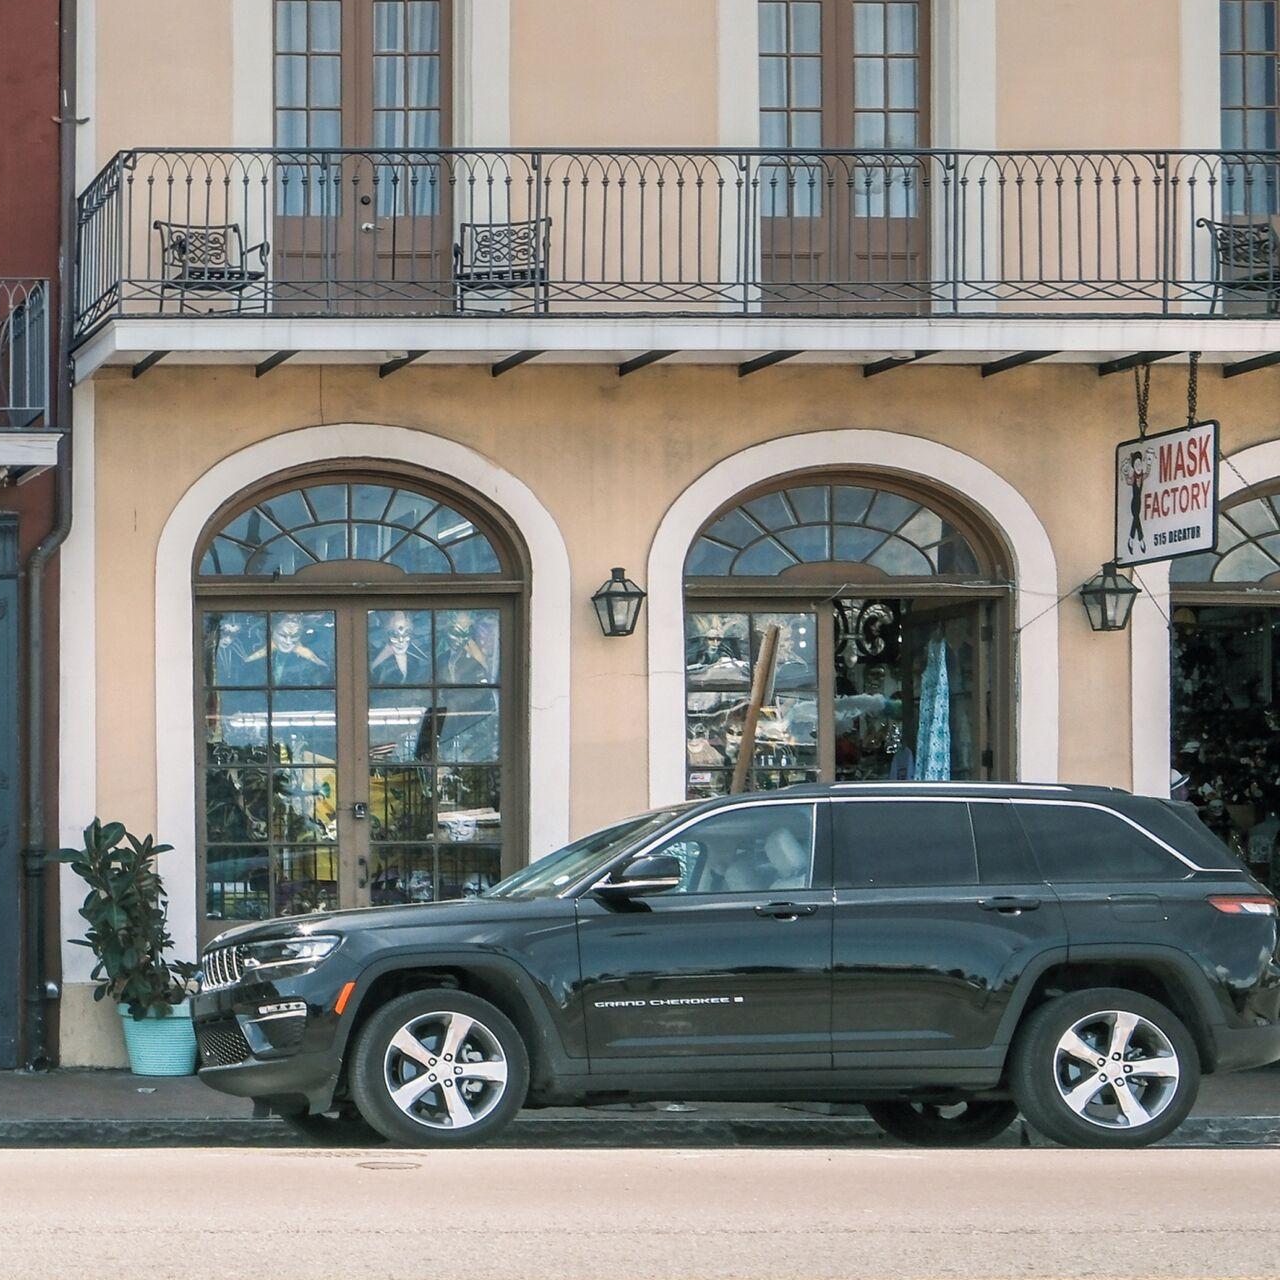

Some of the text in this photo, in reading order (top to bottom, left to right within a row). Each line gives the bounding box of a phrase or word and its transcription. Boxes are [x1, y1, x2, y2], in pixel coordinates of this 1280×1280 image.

[1159, 434, 1211, 483] MASK
[1144, 480, 1211, 520] FACTORY
[1153, 525, 1201, 546] 515 DECATUR
[594, 996, 730, 1008] GRAND CHEROKEE
